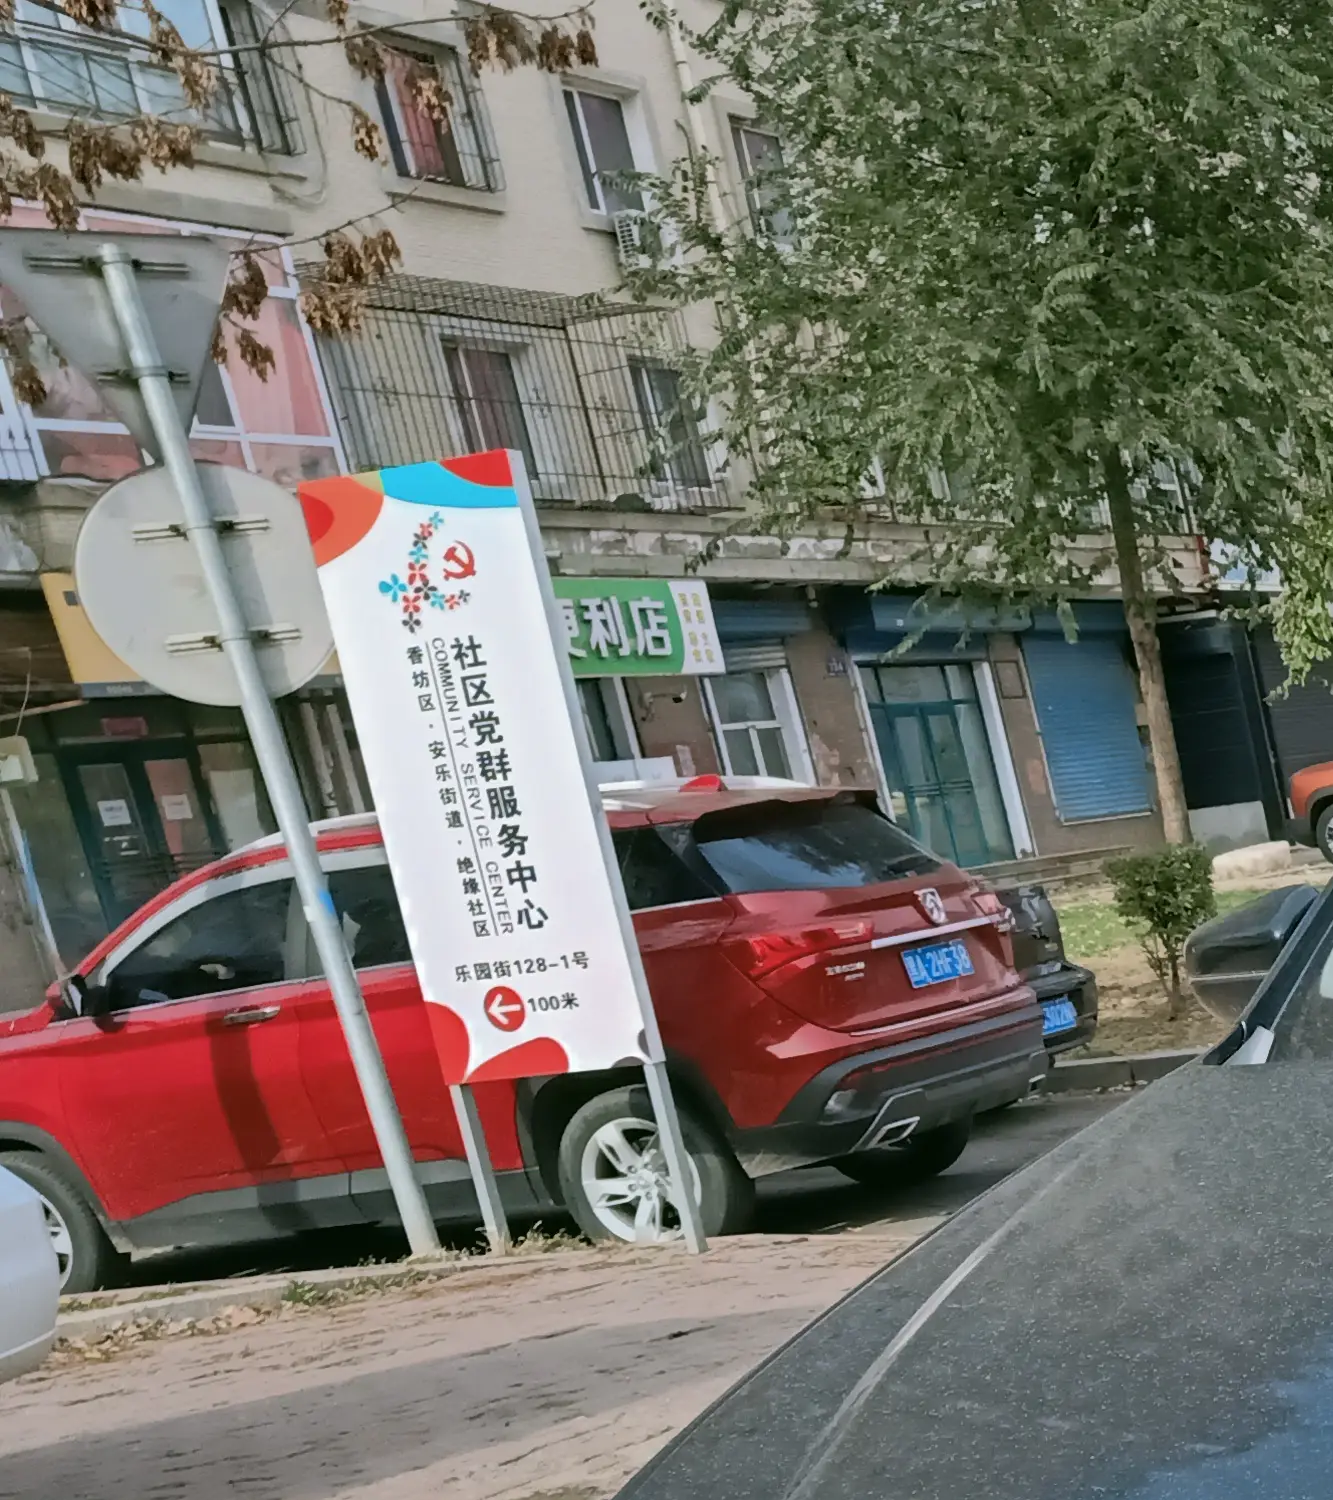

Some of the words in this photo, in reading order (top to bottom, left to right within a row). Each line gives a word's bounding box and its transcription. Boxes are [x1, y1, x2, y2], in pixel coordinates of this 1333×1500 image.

[431, 637, 469, 749] COMMUNITY
[460, 762, 494, 850] SERVICE
[485, 861, 514, 935] CENTER
[450, 634, 549, 930] 社区党群服务中心
[455, 951, 590, 983] 乐园街128-1号
[527, 992, 580, 1013] 100米
